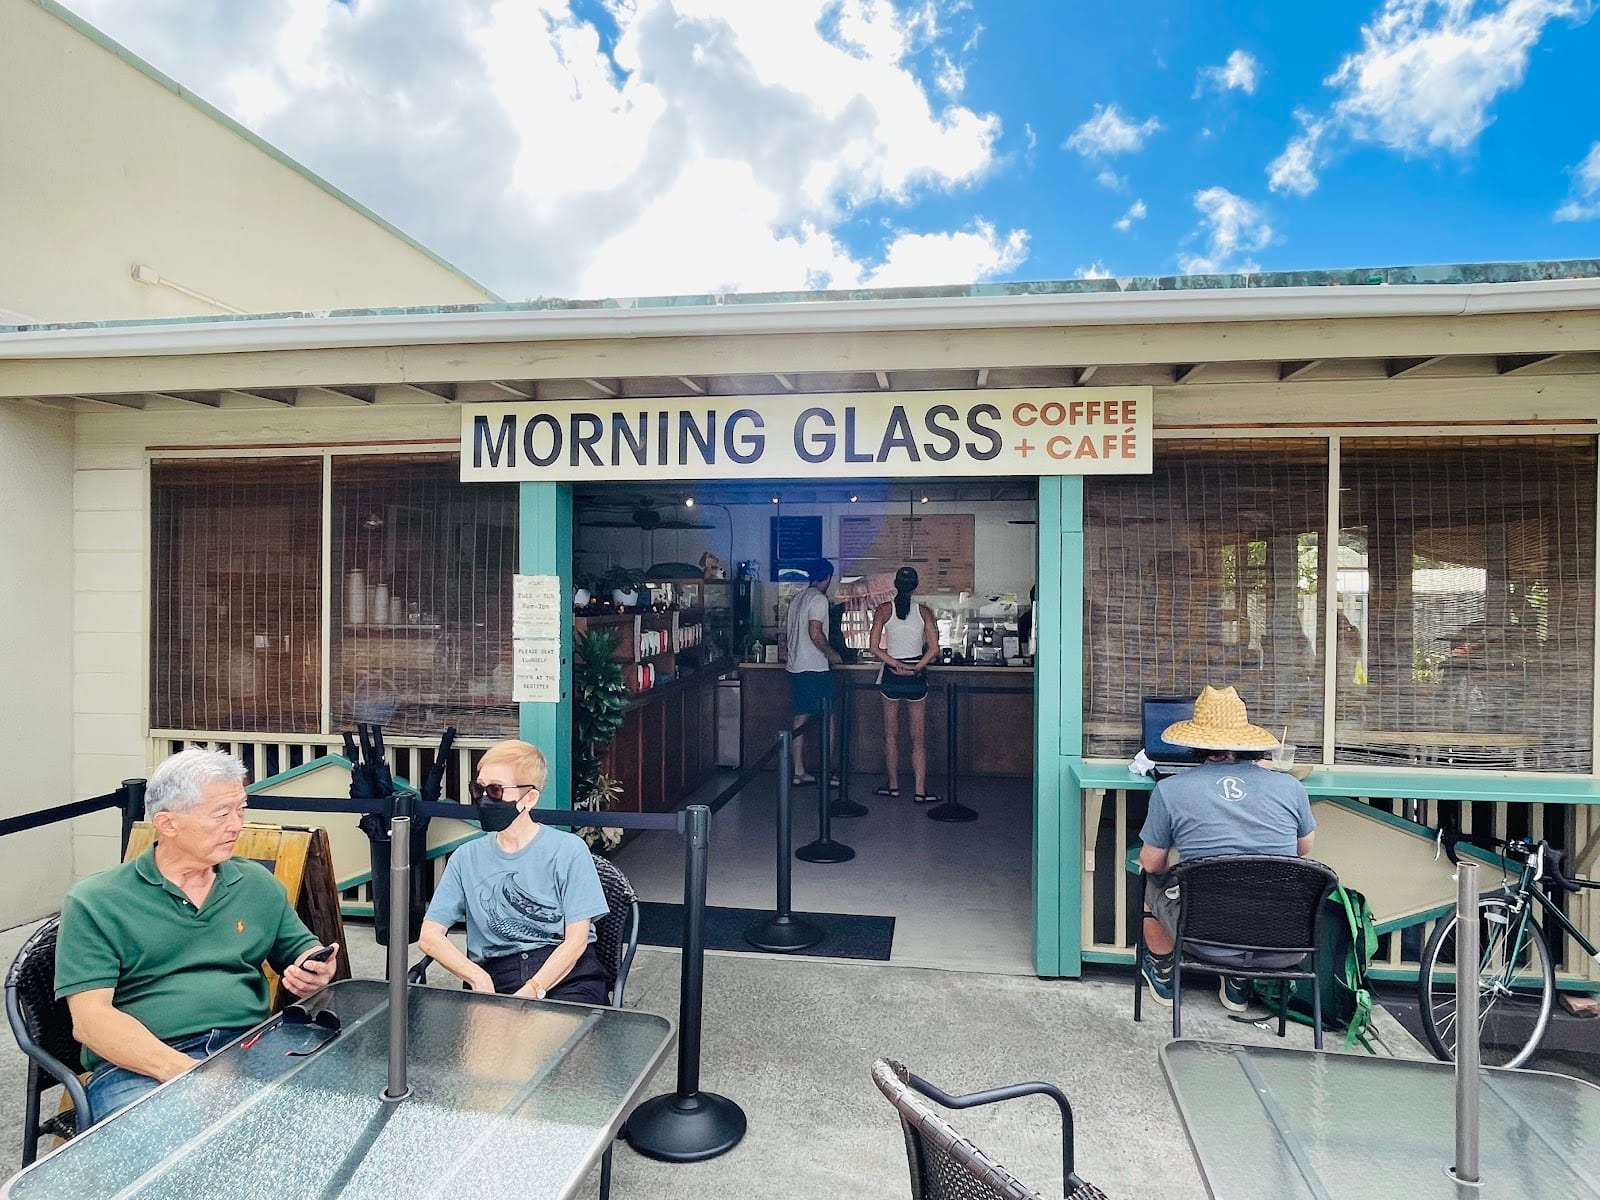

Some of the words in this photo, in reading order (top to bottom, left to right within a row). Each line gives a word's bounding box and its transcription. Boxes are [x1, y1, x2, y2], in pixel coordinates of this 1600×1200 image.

[1012, 401, 1137, 427] COFFEE
[472, 408, 766, 469] MORNING
[793, 404, 1003, 464] GLASS
[1015, 439, 1035, 458] +
[1045, 427, 1137, 460] CAFÉ
